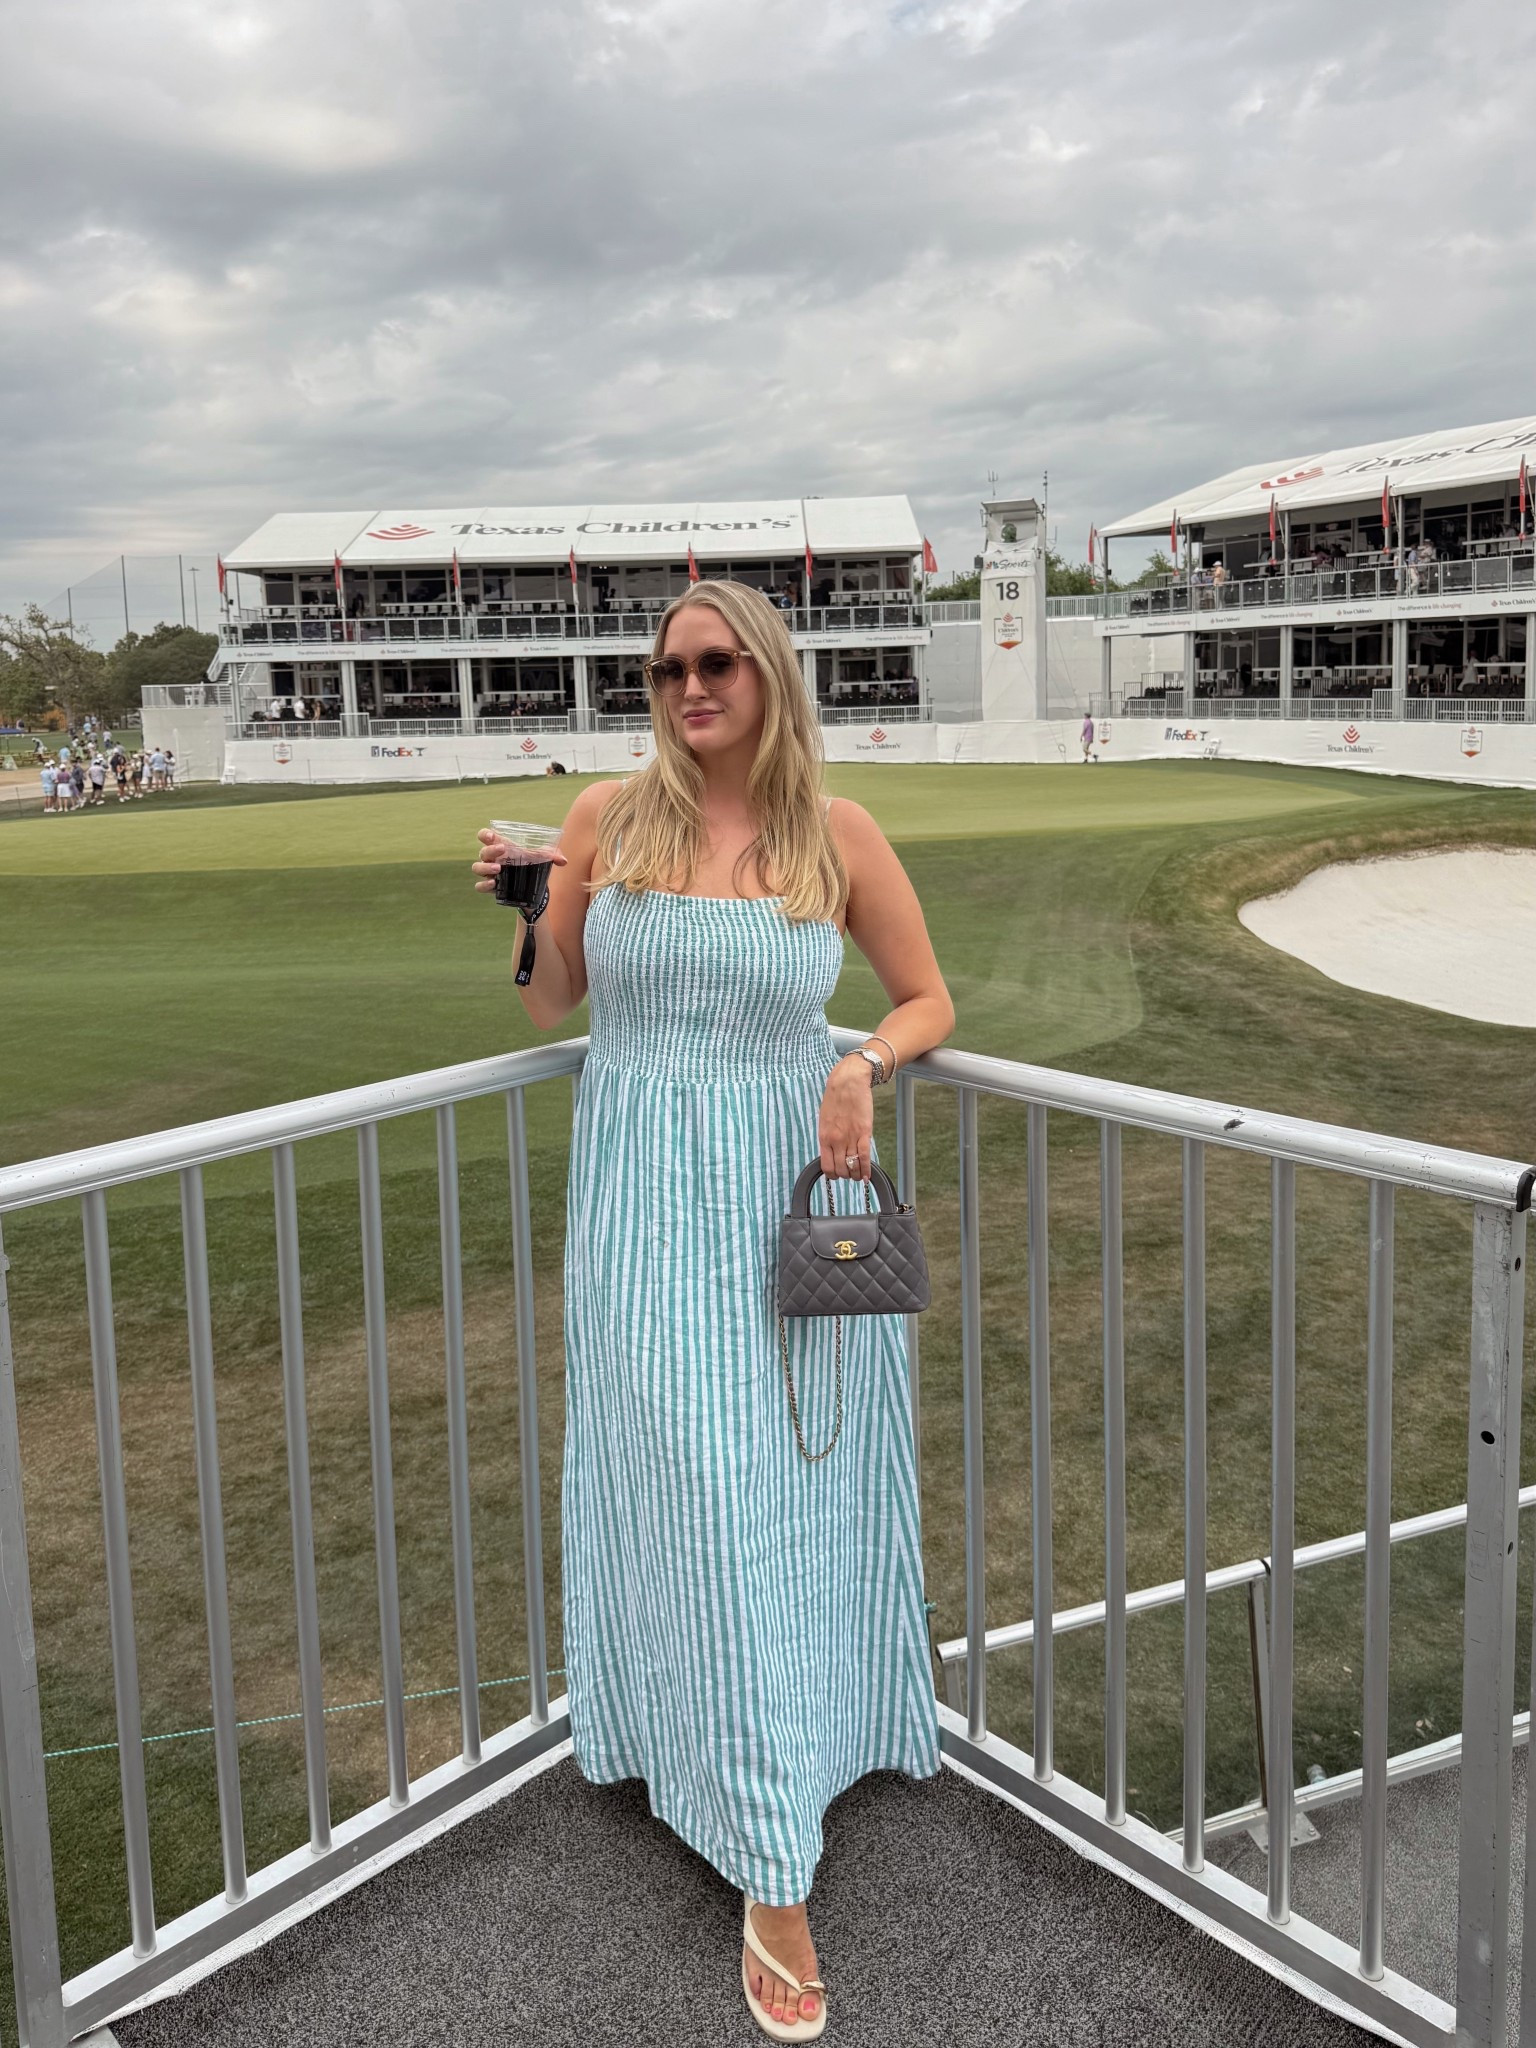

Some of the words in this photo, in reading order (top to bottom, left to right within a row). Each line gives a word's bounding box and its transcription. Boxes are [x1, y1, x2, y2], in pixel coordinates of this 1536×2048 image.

[1336, 448, 1463, 475] Texas
[451, 523, 565, 535] Texas
[576, 518, 791, 534] Children's
[996, 581, 1020, 601] 18
[1172, 729, 1198, 741] FedEx
[381, 747, 413, 758] FedEx
